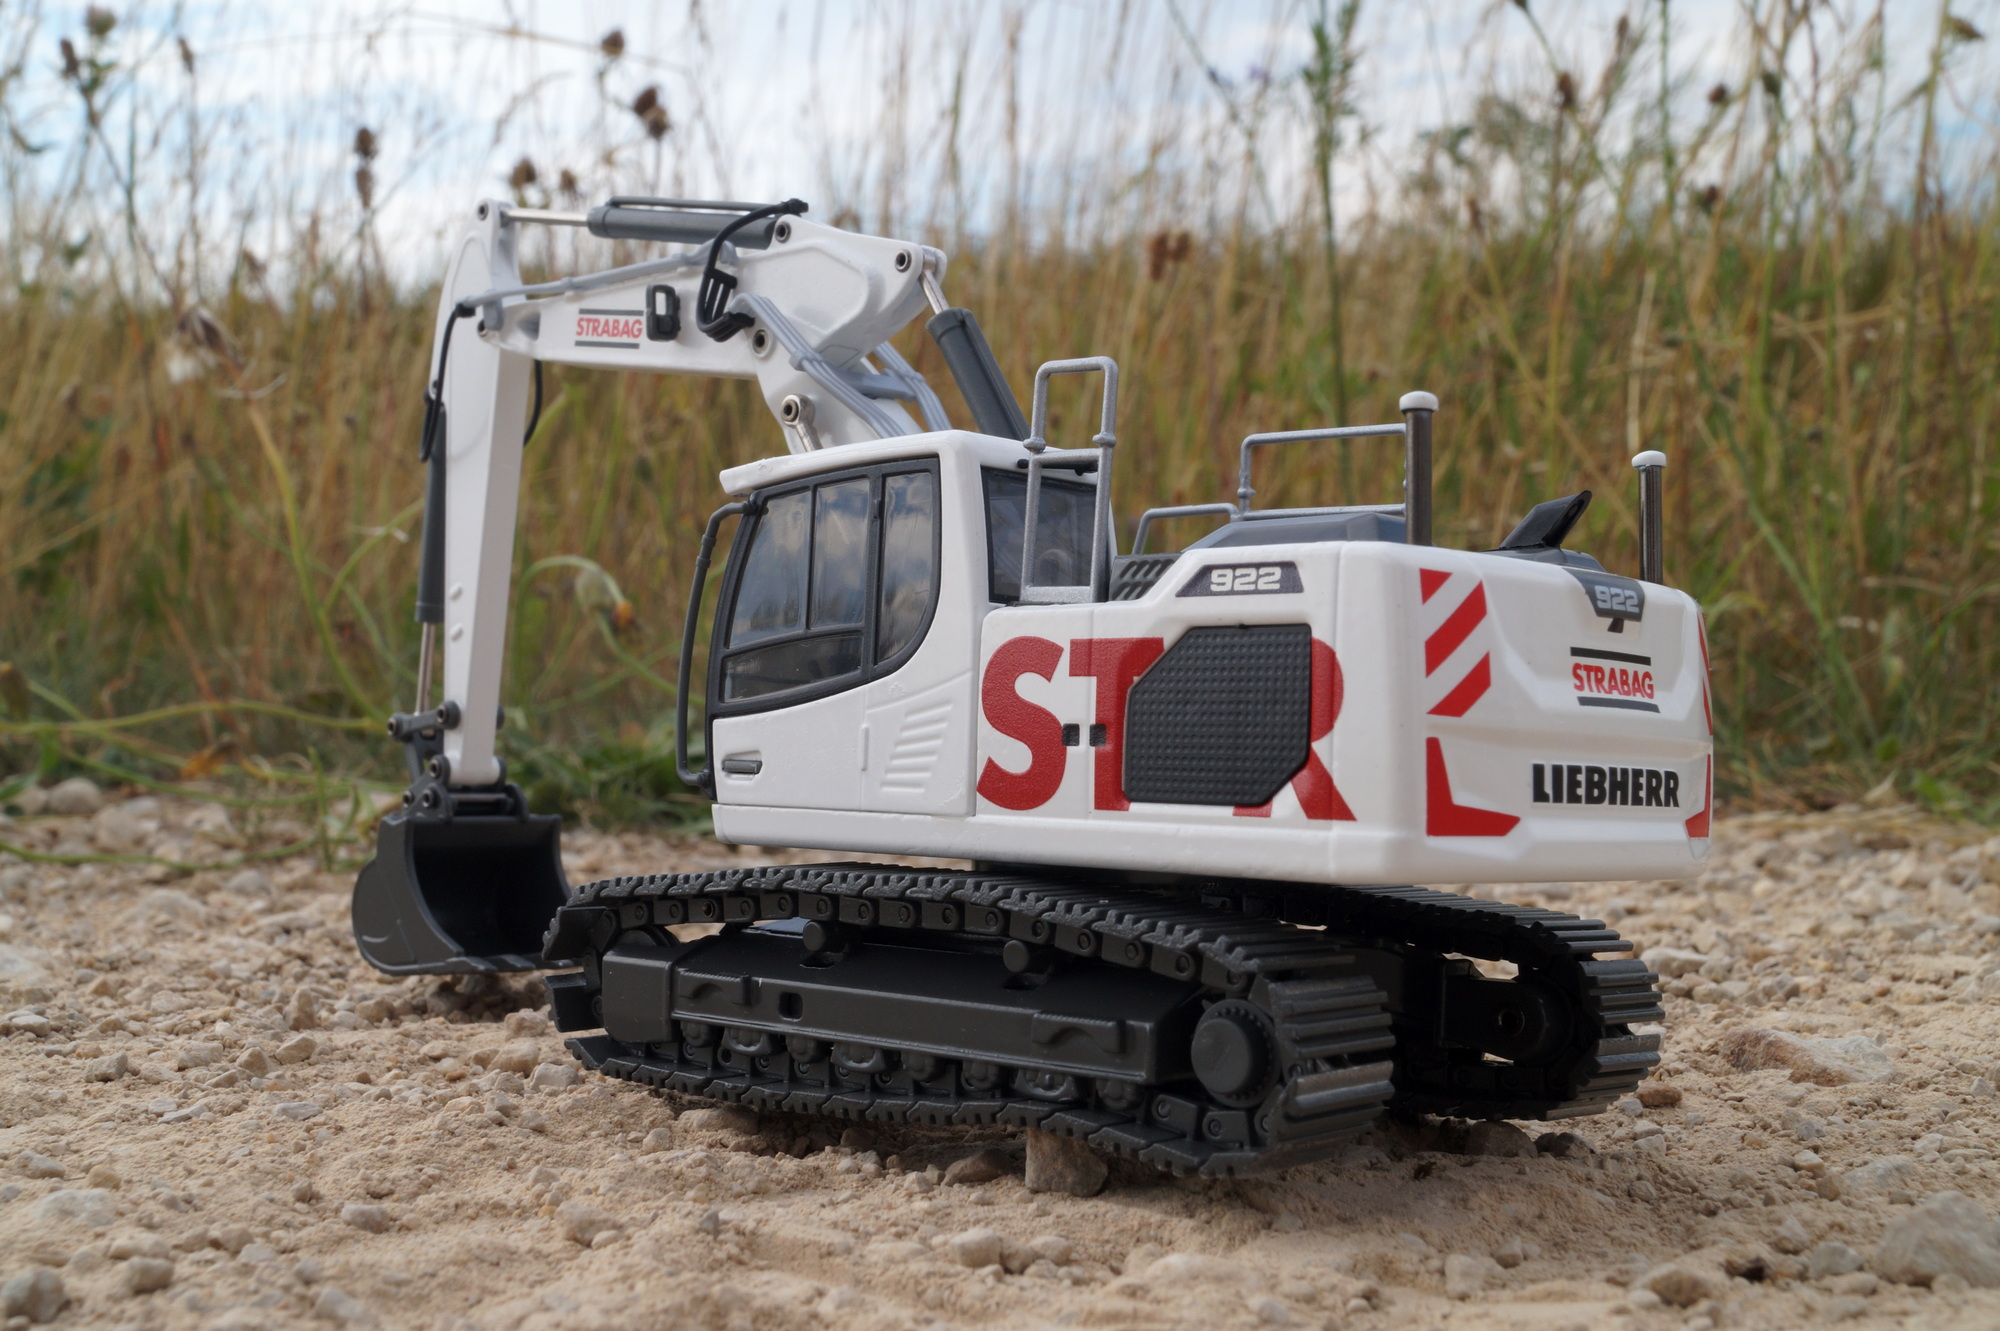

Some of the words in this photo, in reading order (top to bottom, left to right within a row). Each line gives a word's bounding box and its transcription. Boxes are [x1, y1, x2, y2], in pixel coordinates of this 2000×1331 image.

[576, 317, 643, 339] STRABAG
[1210, 567, 1281, 591] 922
[1594, 585, 1640, 613] 922
[1572, 662, 1654, 699] STRABAG
[1532, 763, 1680, 808] LIEBHERR
